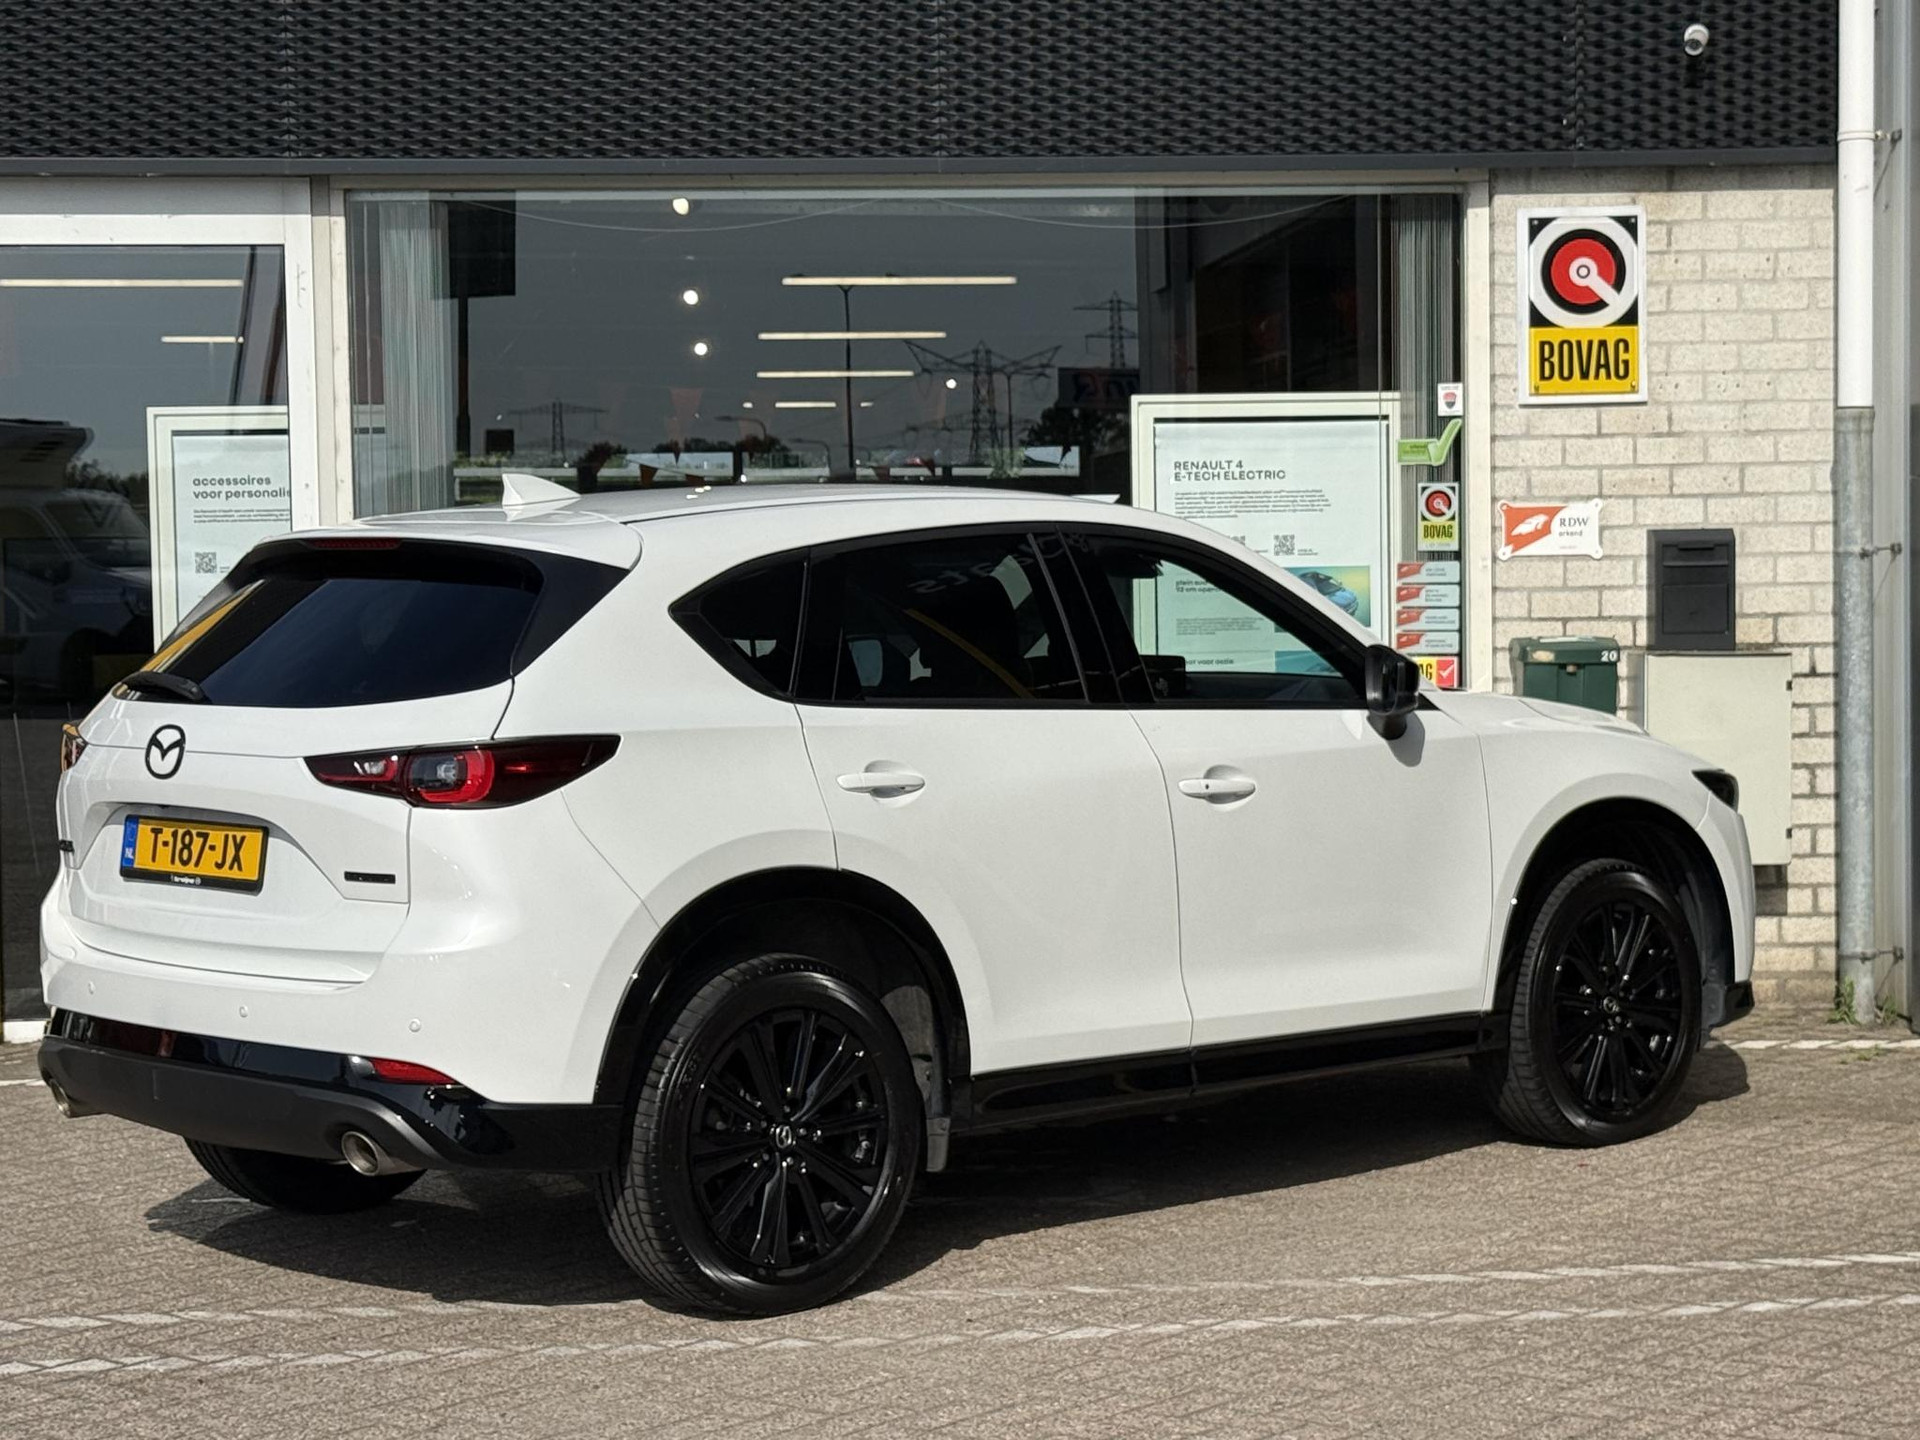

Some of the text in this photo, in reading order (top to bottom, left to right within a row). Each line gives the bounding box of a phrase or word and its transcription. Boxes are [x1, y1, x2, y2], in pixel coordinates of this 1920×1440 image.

[1538, 338, 1630, 381] BOVAG
[1174, 460, 1244, 471] RENAULT 4
[192, 474, 272, 487] accessoires
[1174, 470, 1286, 482] E-TECH ELECTRIC
[193, 490, 222, 499] voor
[1559, 517, 1590, 527] RDW
[1423, 524, 1453, 539] BOVAG
[1601, 650, 1618, 662] 20
[124, 848, 134, 859] NL
[150, 828, 246, 871] T-187-JX
